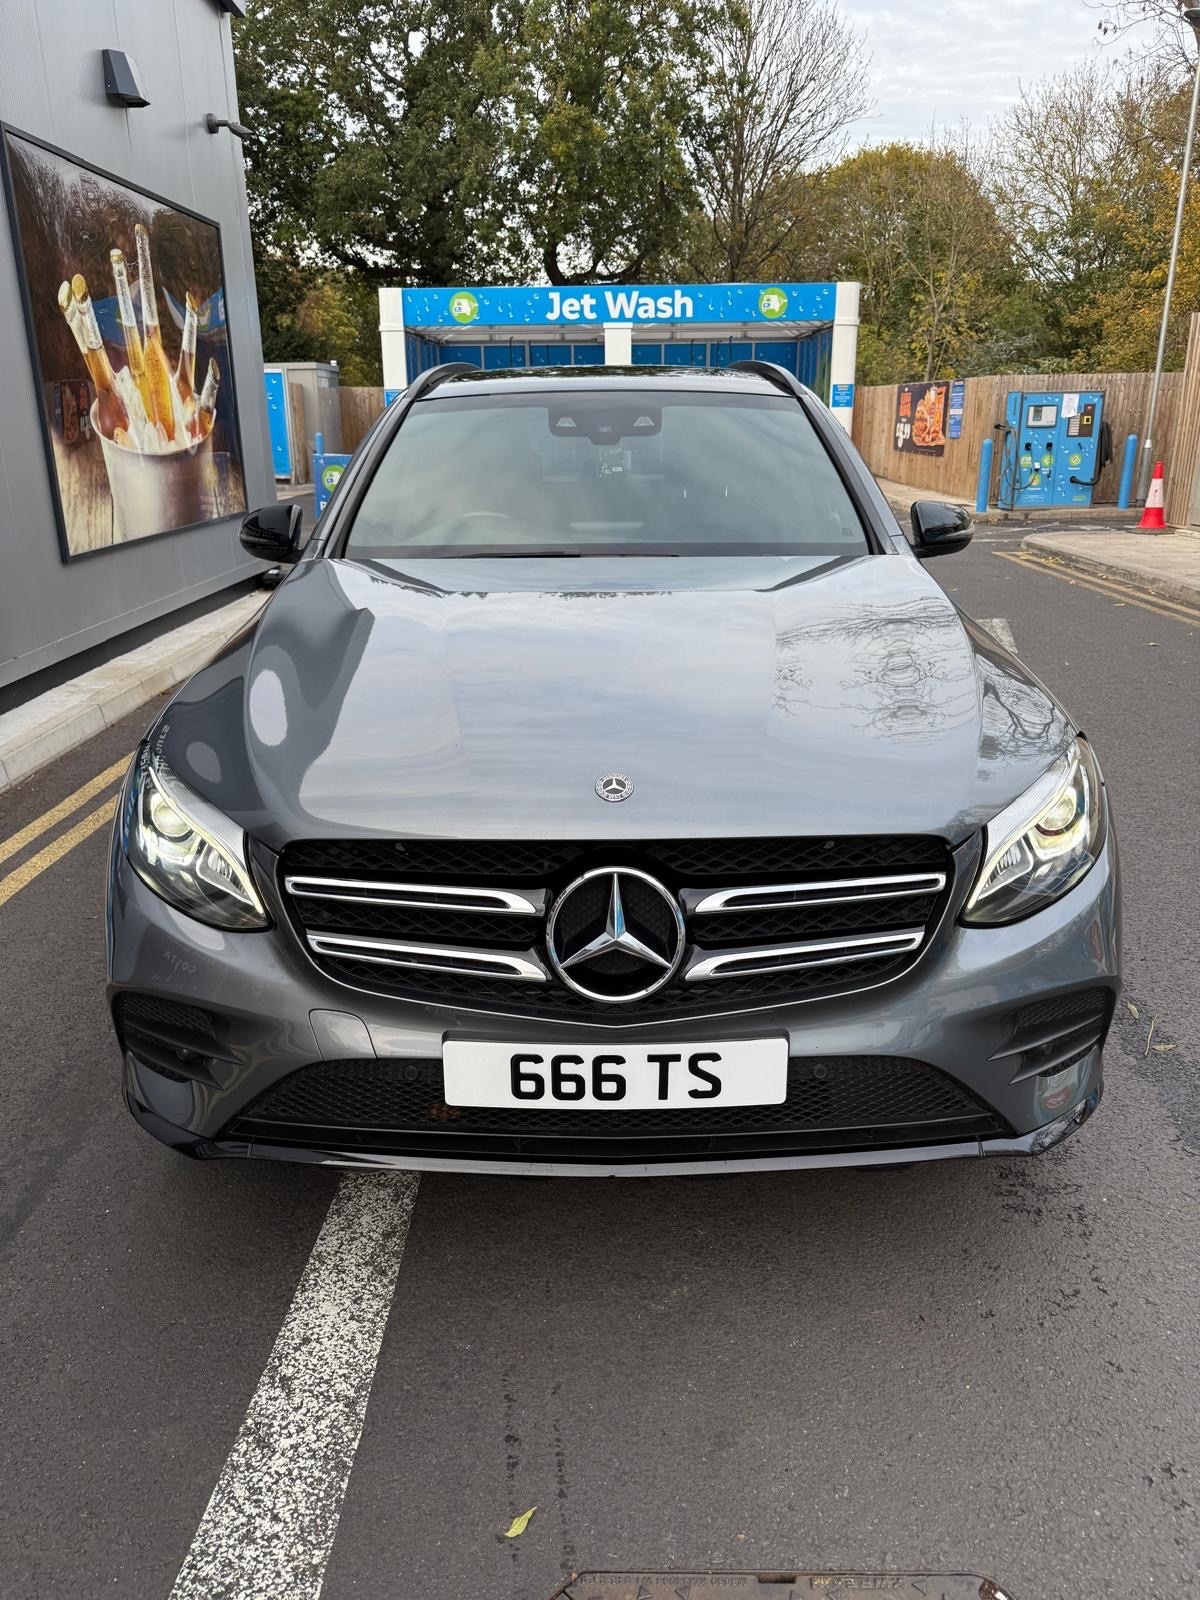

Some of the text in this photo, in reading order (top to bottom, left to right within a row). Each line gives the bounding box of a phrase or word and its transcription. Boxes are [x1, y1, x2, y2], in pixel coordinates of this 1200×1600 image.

[545, 289, 694, 320] Jet Wash
[510, 1052, 722, 1101] 666 TS
